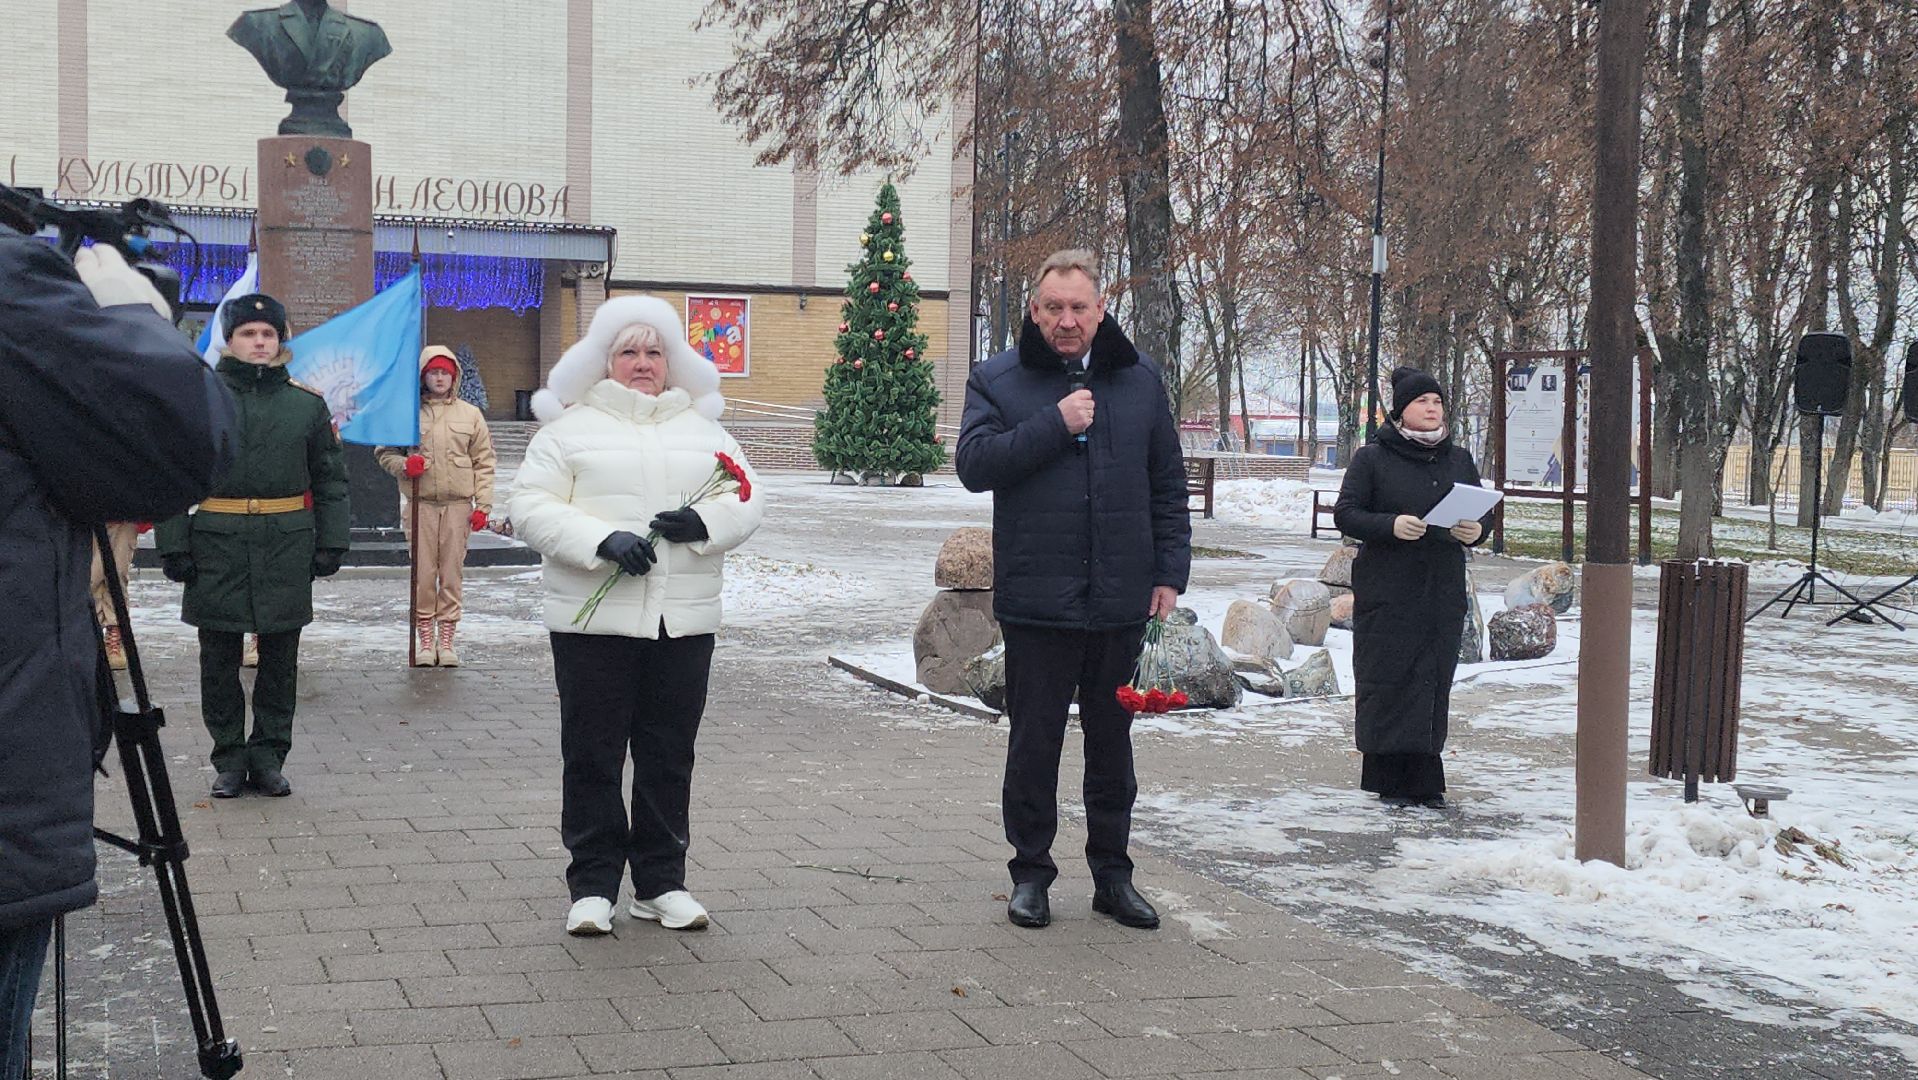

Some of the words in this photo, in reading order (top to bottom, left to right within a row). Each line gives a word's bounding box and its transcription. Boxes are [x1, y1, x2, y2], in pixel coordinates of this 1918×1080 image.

[57, 157, 249, 201] КУЛЬТУРЫ
[374, 175, 402, 210] Н.
[411, 176, 570, 218] ЛЕОНОВА
